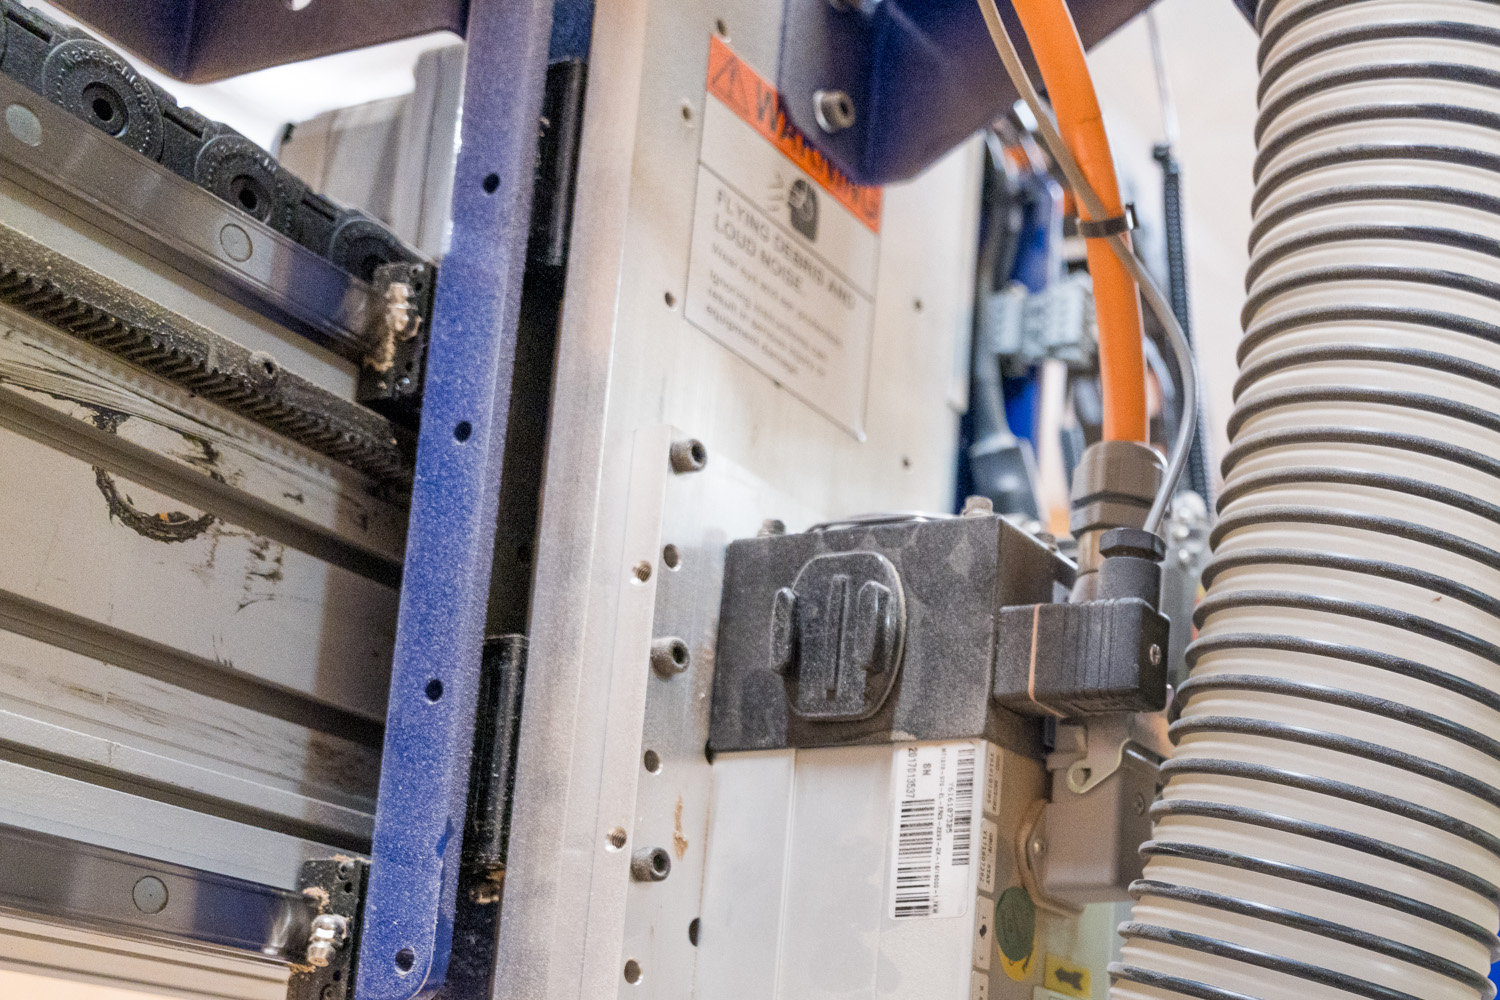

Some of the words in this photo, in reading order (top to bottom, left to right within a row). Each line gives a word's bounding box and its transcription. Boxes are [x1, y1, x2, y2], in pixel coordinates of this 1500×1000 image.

[713, 213, 757, 257] LOUD
[760, 250, 804, 293] NOISE
[717, 188, 770, 242] FLYING
[774, 234, 825, 285] DEBRIS
[906, 747, 918, 799] 2017013537
